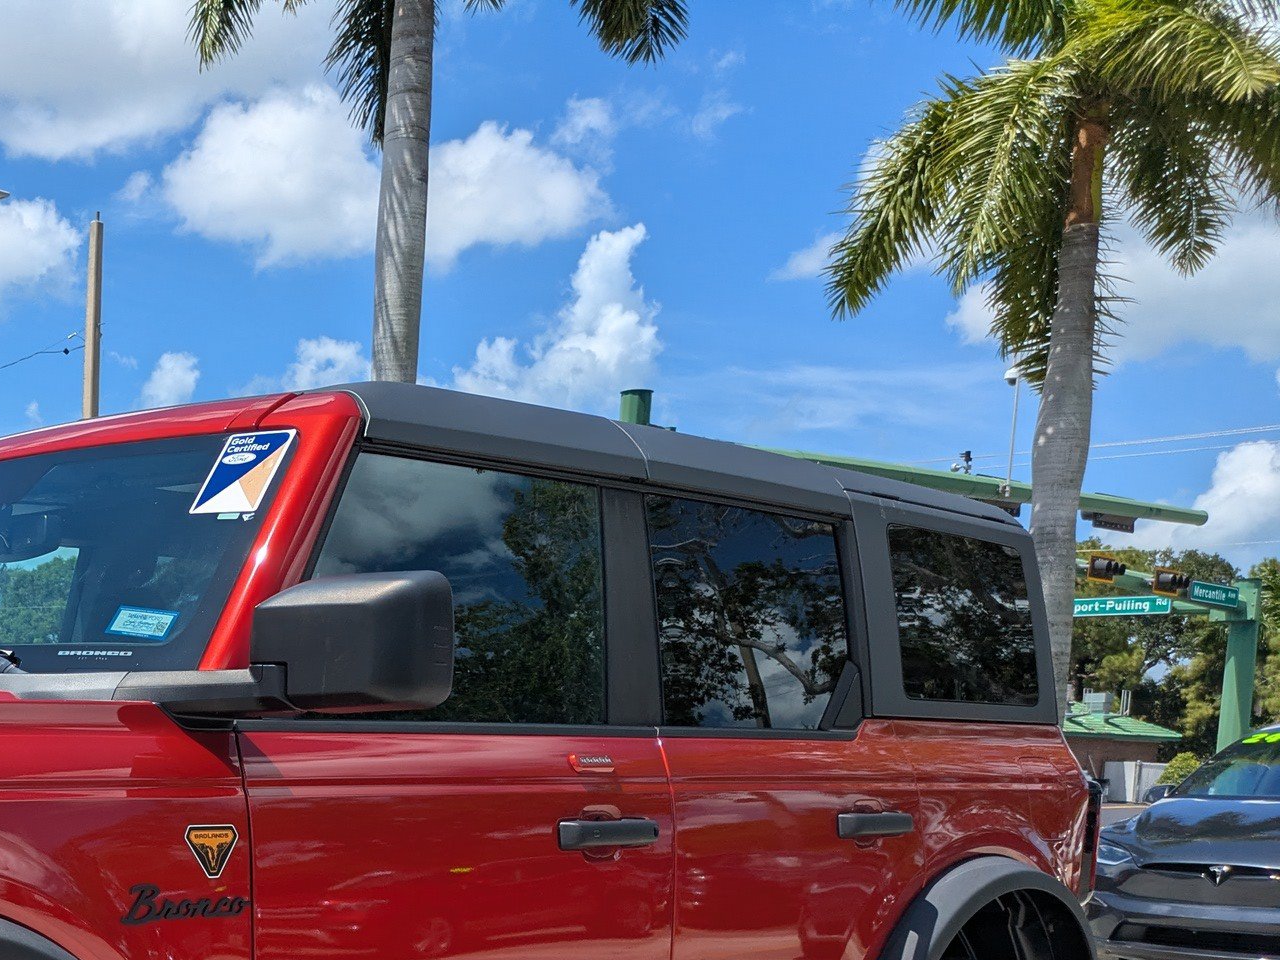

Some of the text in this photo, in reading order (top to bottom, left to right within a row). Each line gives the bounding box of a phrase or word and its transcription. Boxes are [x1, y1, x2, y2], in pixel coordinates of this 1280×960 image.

[227, 443, 270, 453] Certified
[231, 437, 255, 445] Gold
[1194, 586, 1226, 601] Mercantile
[1073, 600, 1150, 614] port-Pulling
[121, 884, 251, 925] Bronco
